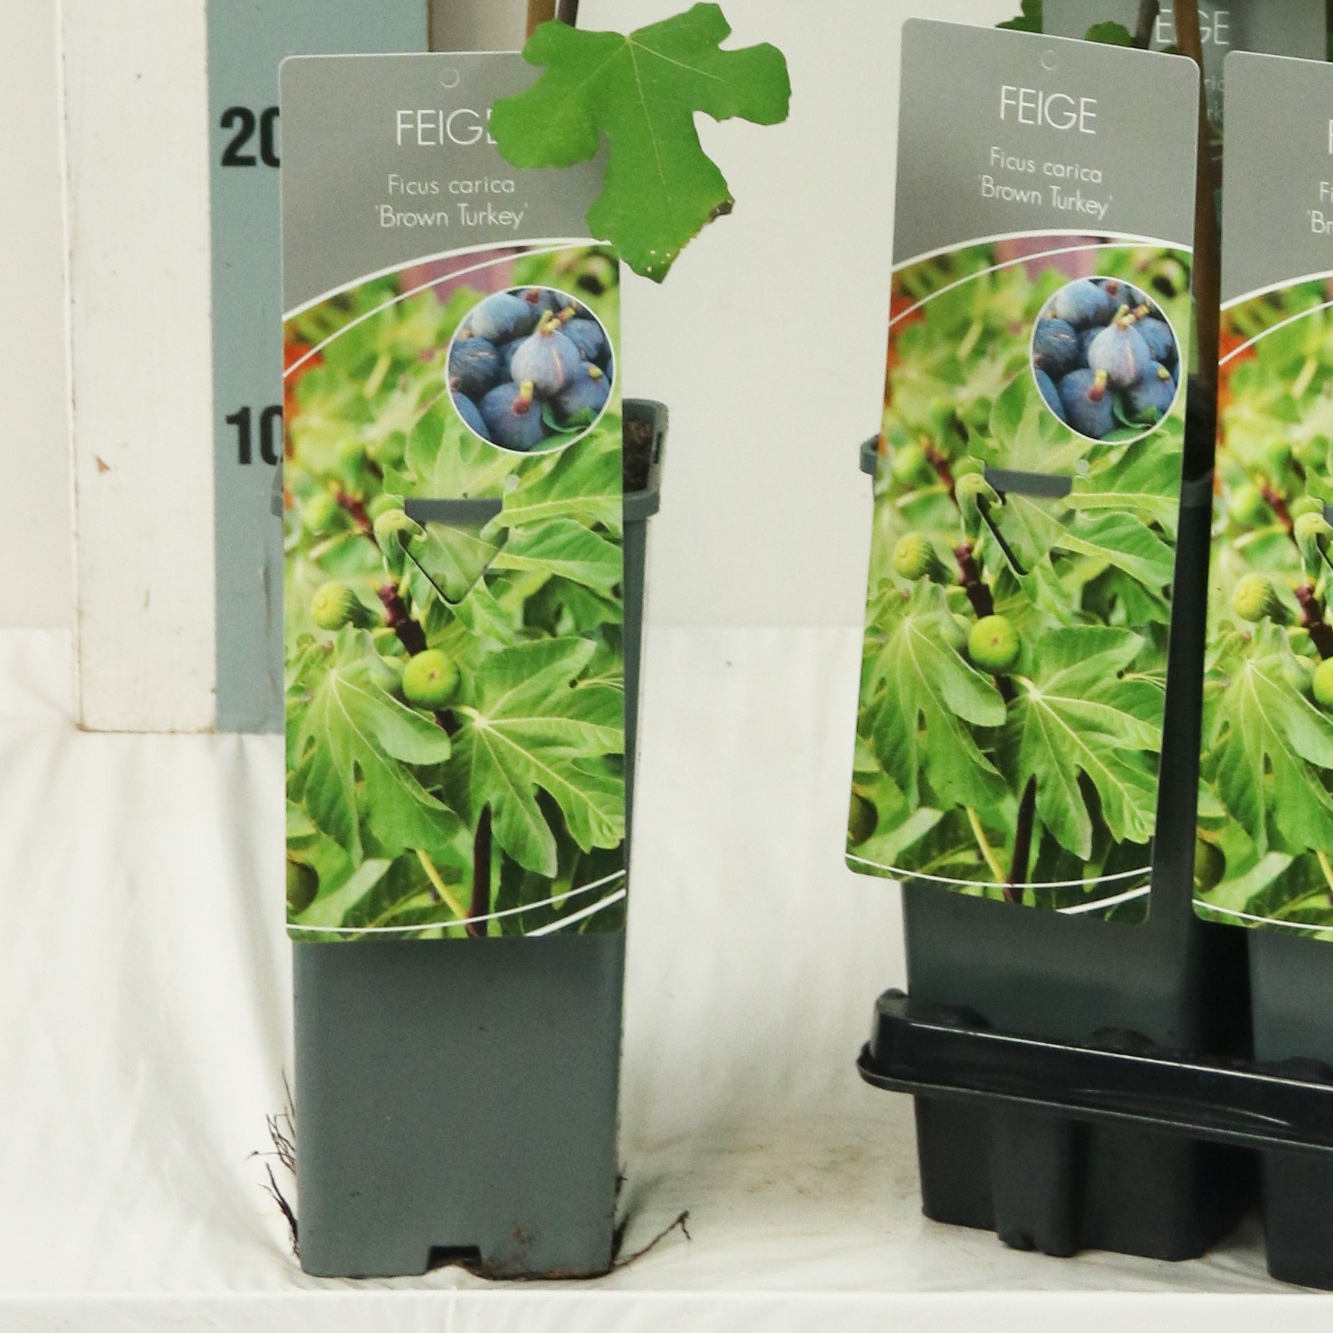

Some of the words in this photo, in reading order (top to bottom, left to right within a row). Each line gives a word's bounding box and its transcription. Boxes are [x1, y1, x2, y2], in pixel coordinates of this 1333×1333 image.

[1000, 85, 1098, 134] FEIGE
[388, 174, 440, 195] Ficus
[448, 177, 516, 194] carica
[990, 146, 1036, 174] Ficus
[1042, 162, 1103, 184] carica
[374, 203, 449, 228] 'Brown
[457, 202, 528, 230] Turkey'
[977, 174, 1042, 206] 'Brown
[1049, 185, 1113, 221] Turkey'
[225, 404, 283, 465] 10
